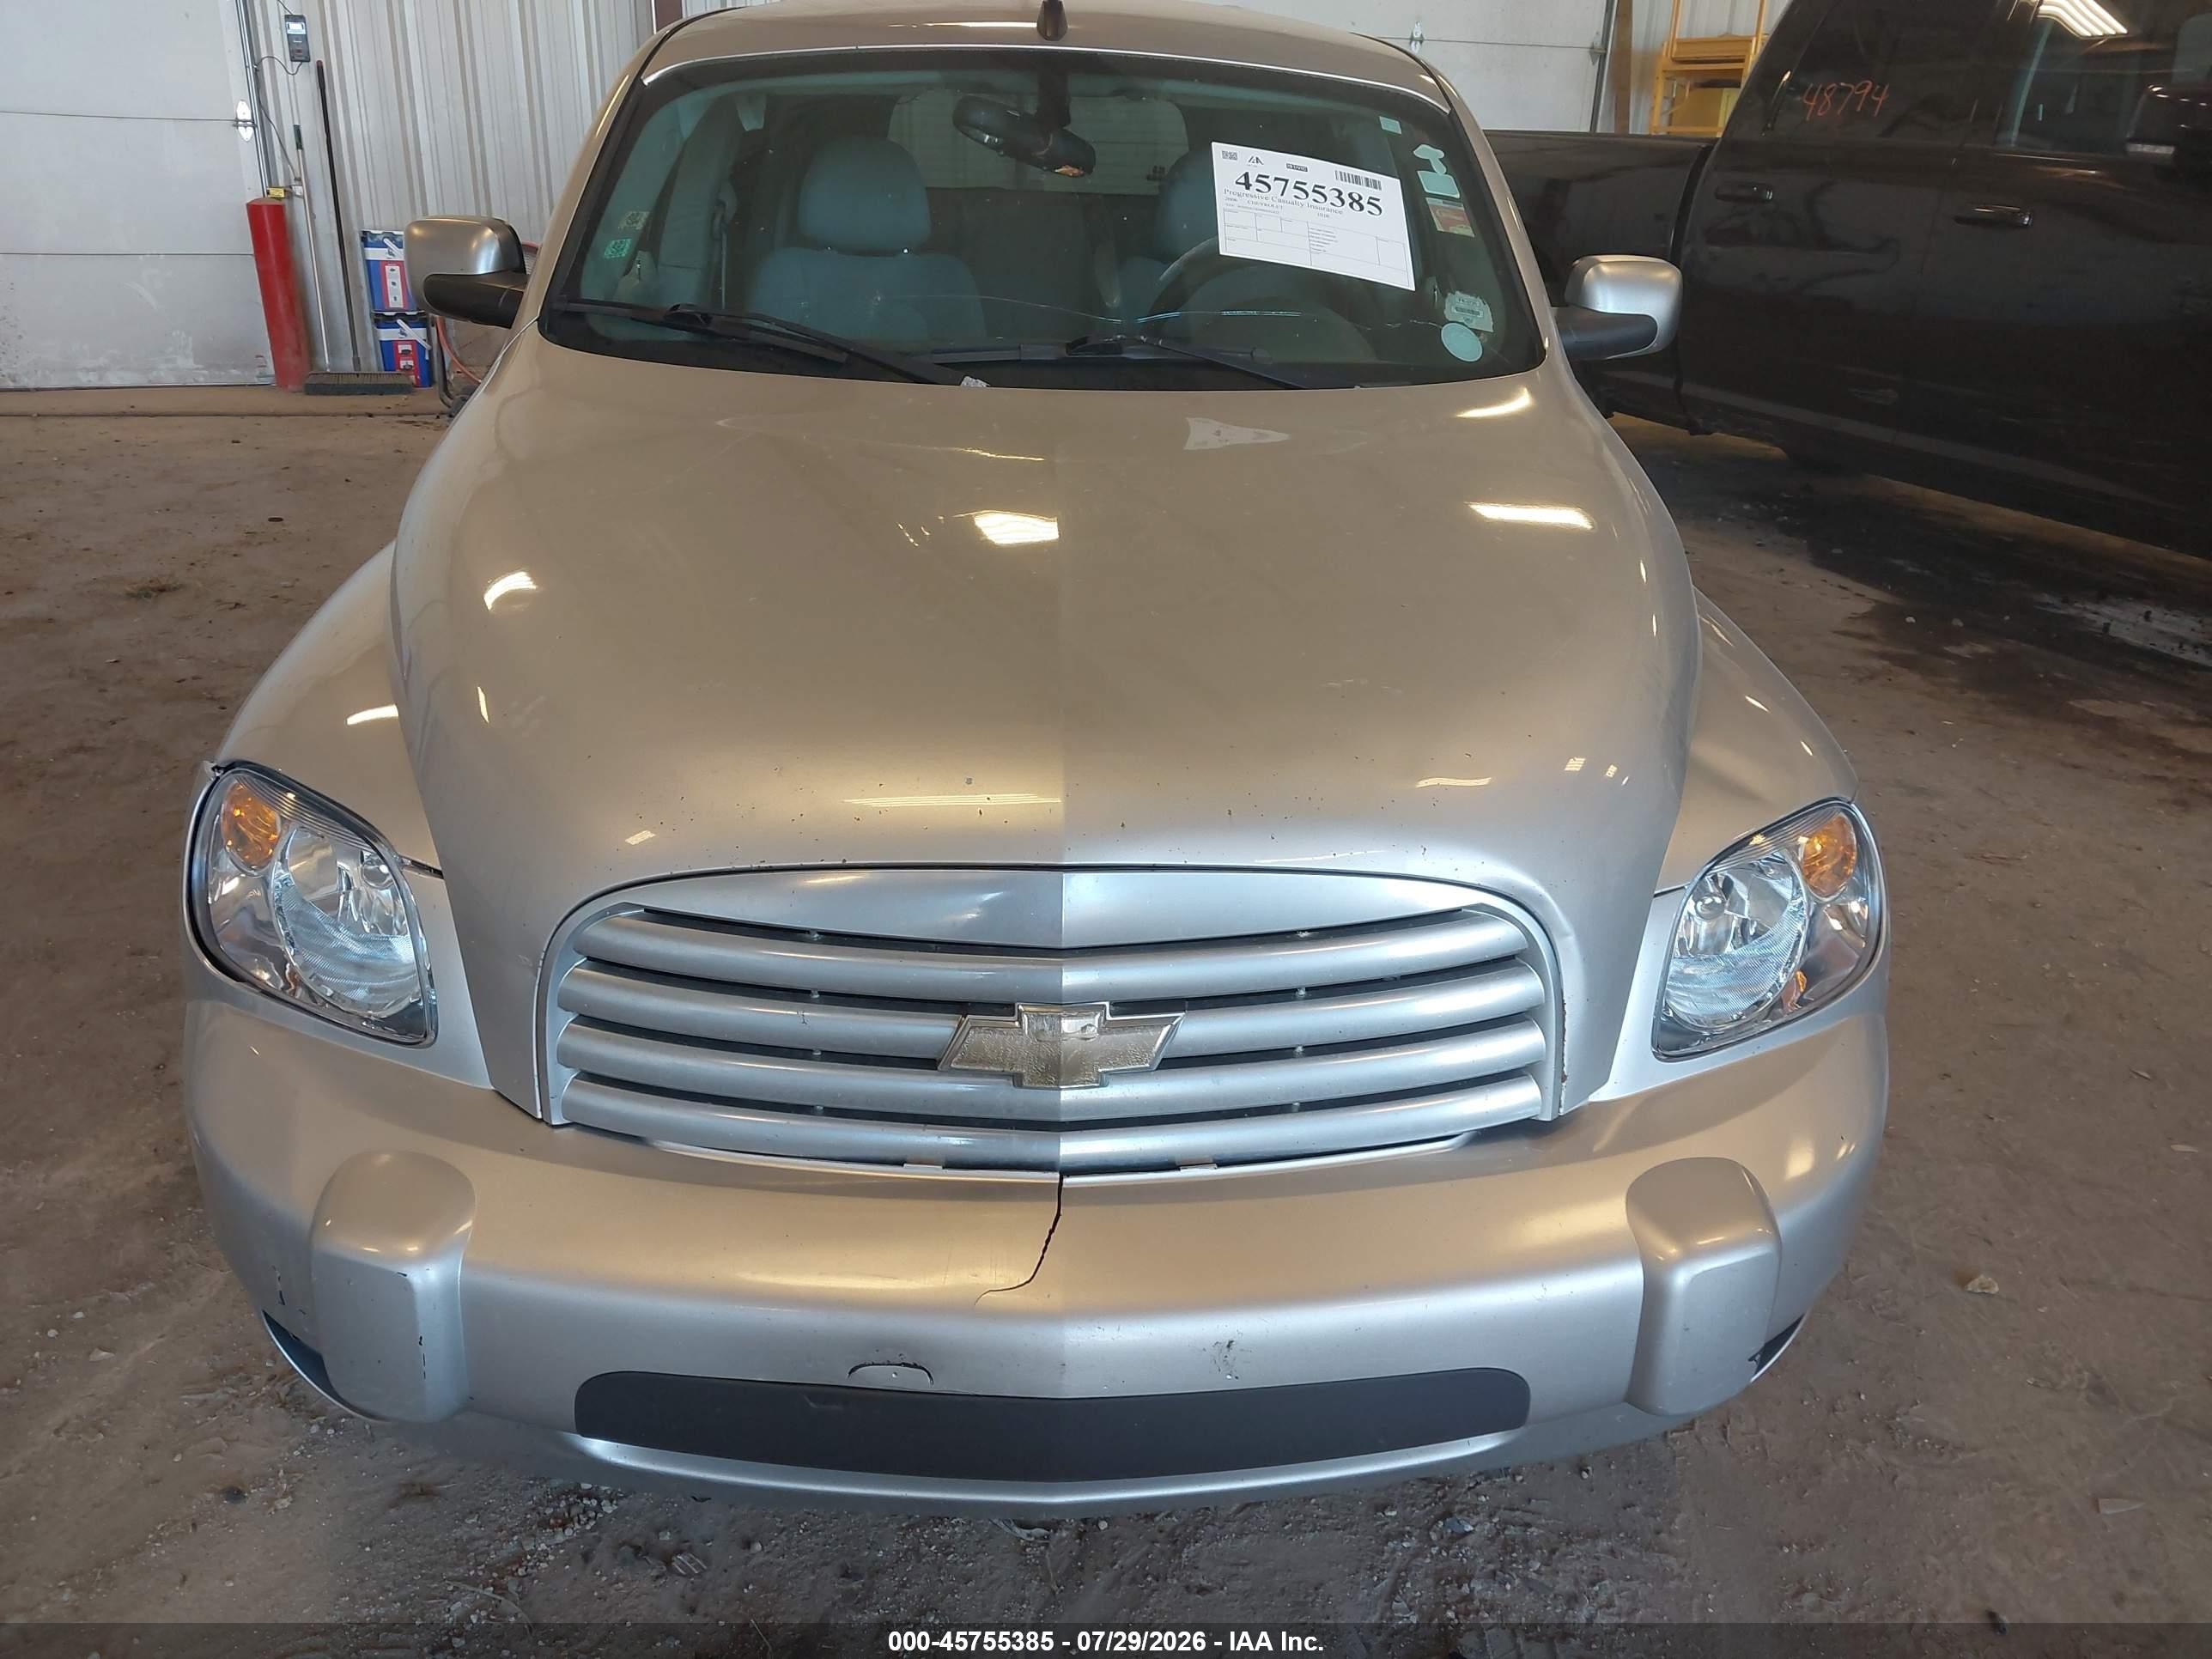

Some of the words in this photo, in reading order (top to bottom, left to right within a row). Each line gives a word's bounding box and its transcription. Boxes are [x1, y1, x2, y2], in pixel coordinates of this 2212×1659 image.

[1802, 80, 1890, 122] 48794
[1224, 188, 1269, 202] Progressive
[1271, 196, 1305, 208] Casualty
[1307, 203, 1344, 215] Insurance
[1235, 171, 1383, 216] 45755385
